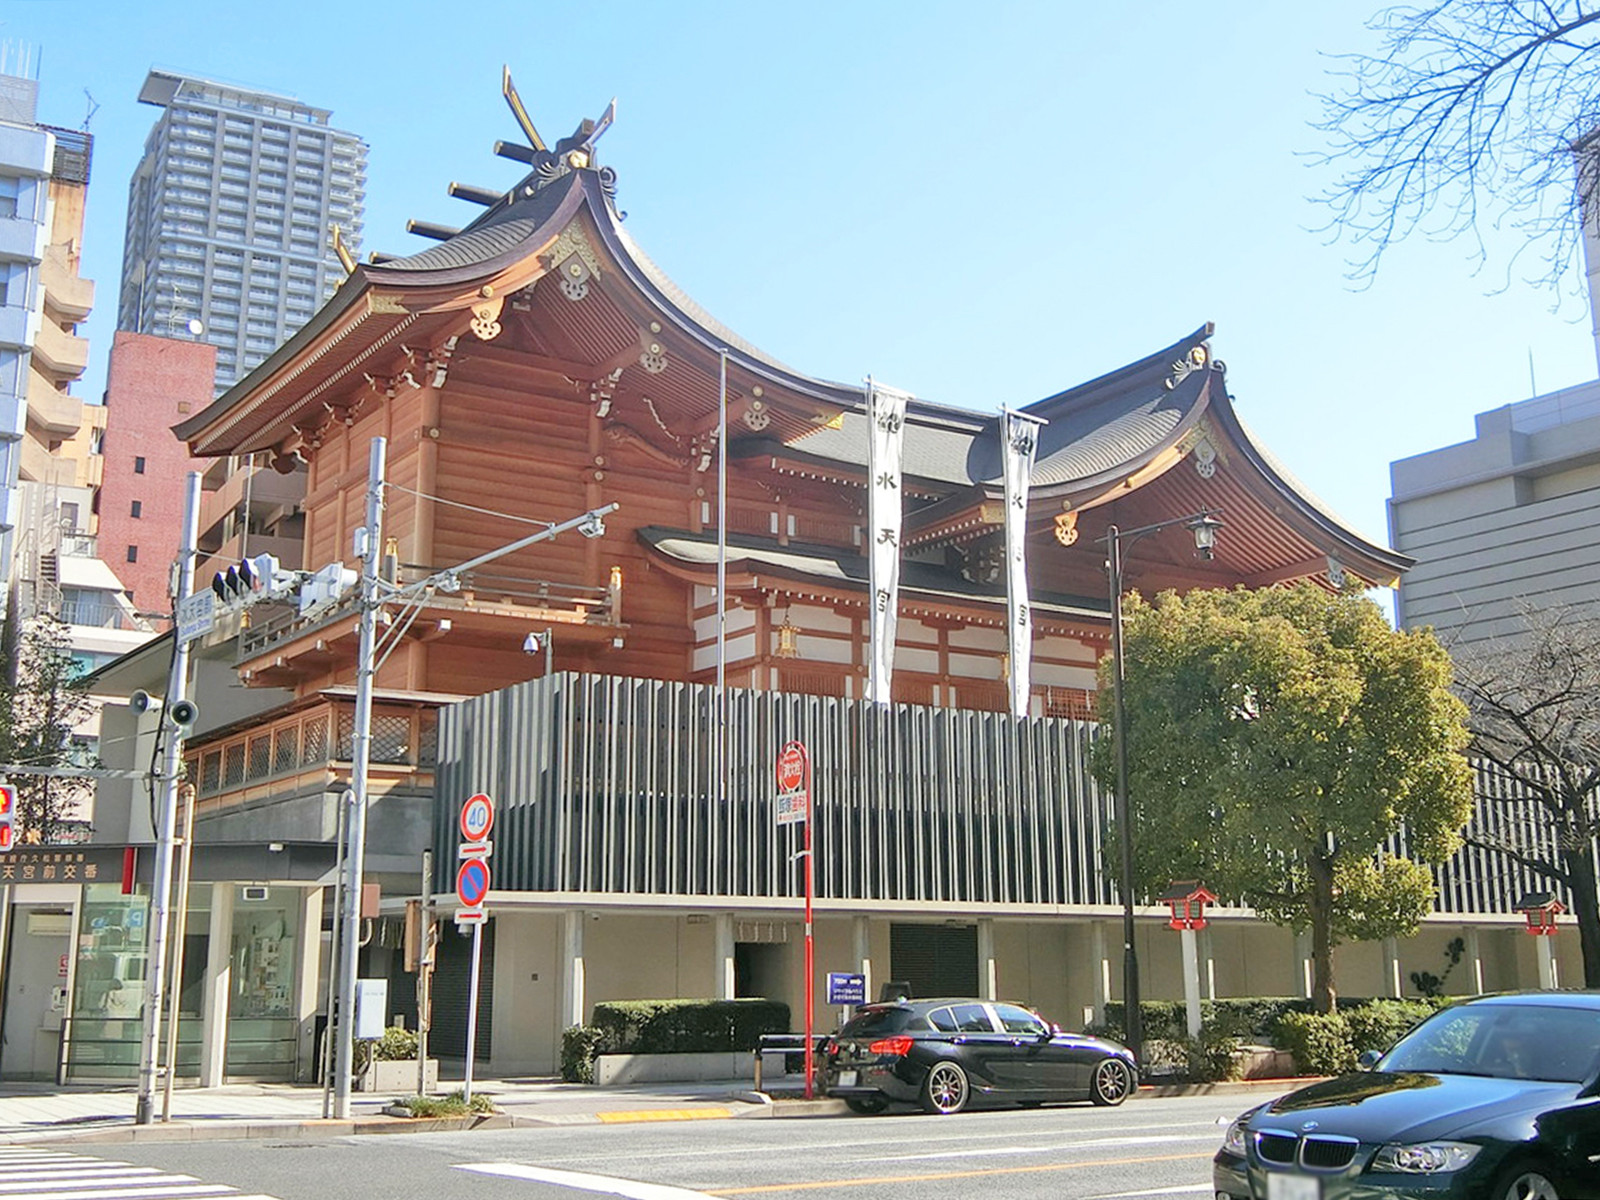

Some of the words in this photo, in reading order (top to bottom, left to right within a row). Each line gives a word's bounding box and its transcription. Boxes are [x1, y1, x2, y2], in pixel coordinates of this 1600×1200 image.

[469, 806, 486, 827] 40
[2, 864, 98, 879] 天宮前交番
